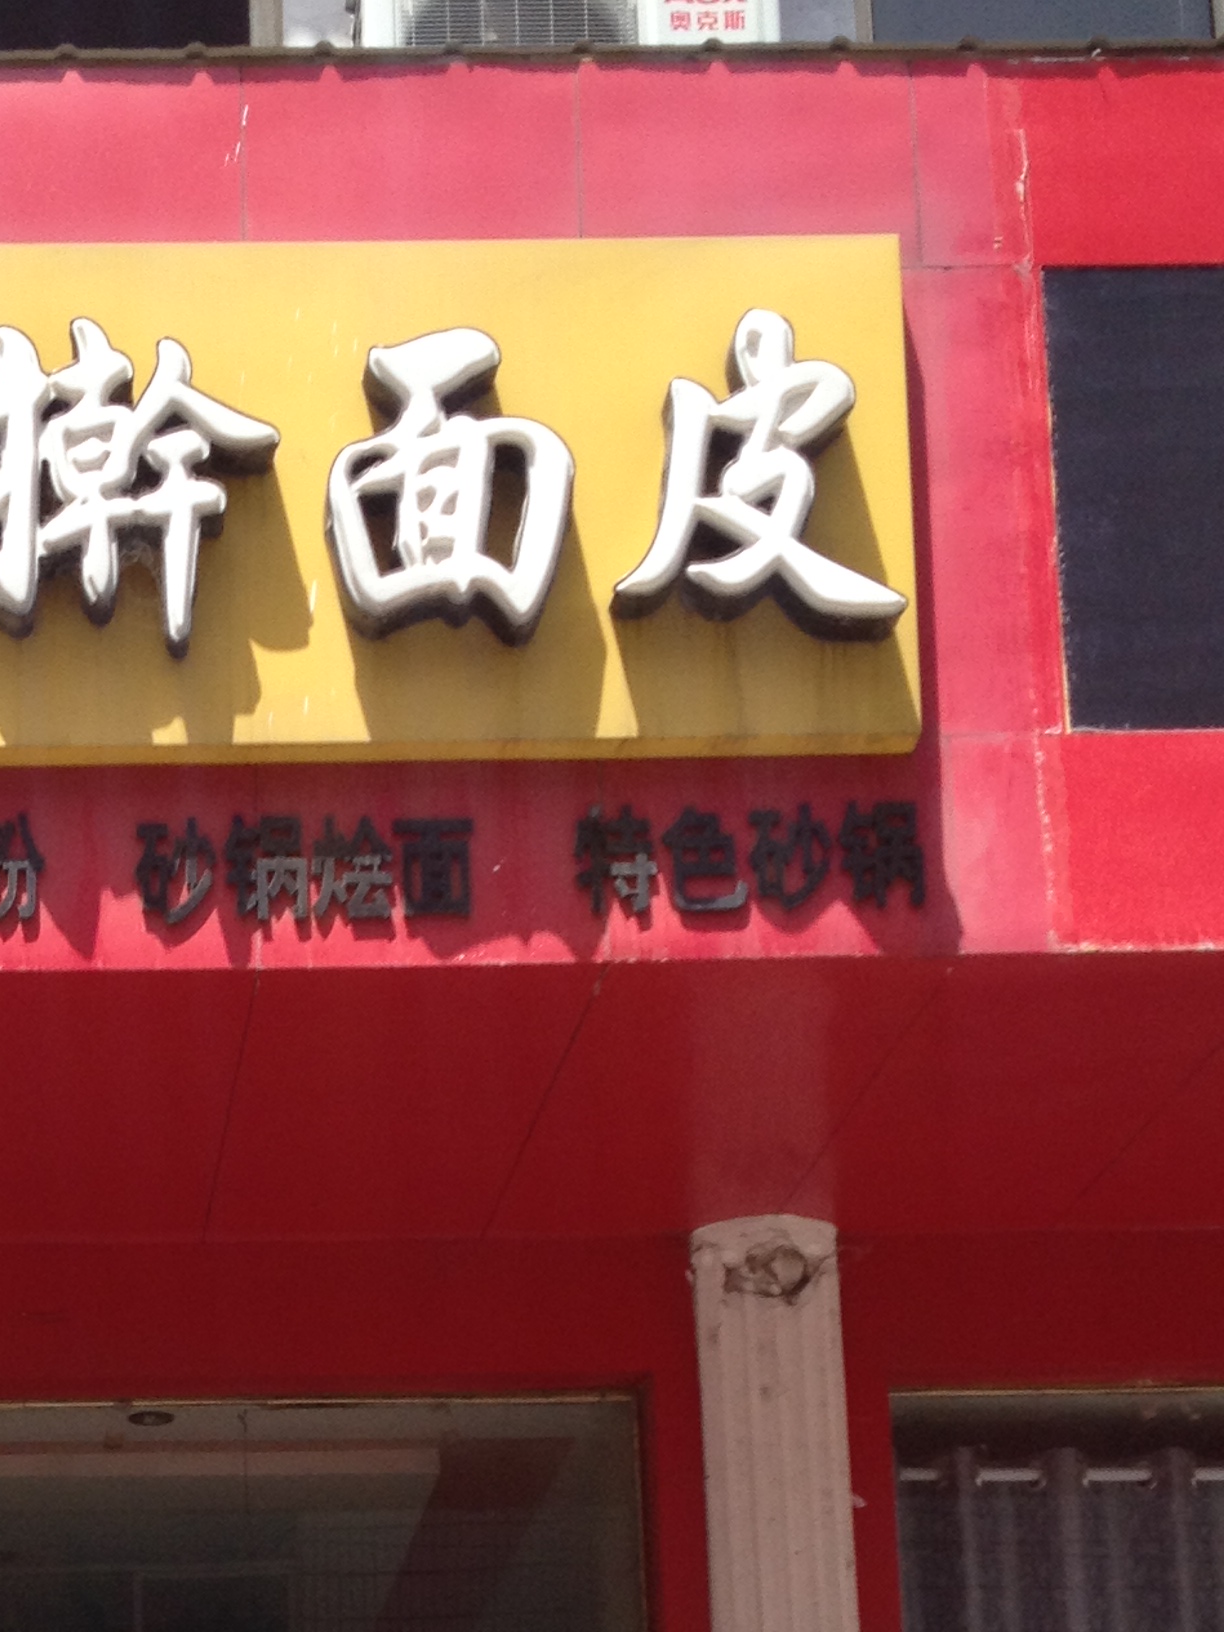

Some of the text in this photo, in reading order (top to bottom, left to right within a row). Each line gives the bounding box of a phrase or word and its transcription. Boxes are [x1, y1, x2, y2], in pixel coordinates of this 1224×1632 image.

[670, 11, 745, 31] 奥克斯
[133, 812, 476, 924] 砂锅烩面
[573, 801, 929, 916] 特色砂锅
